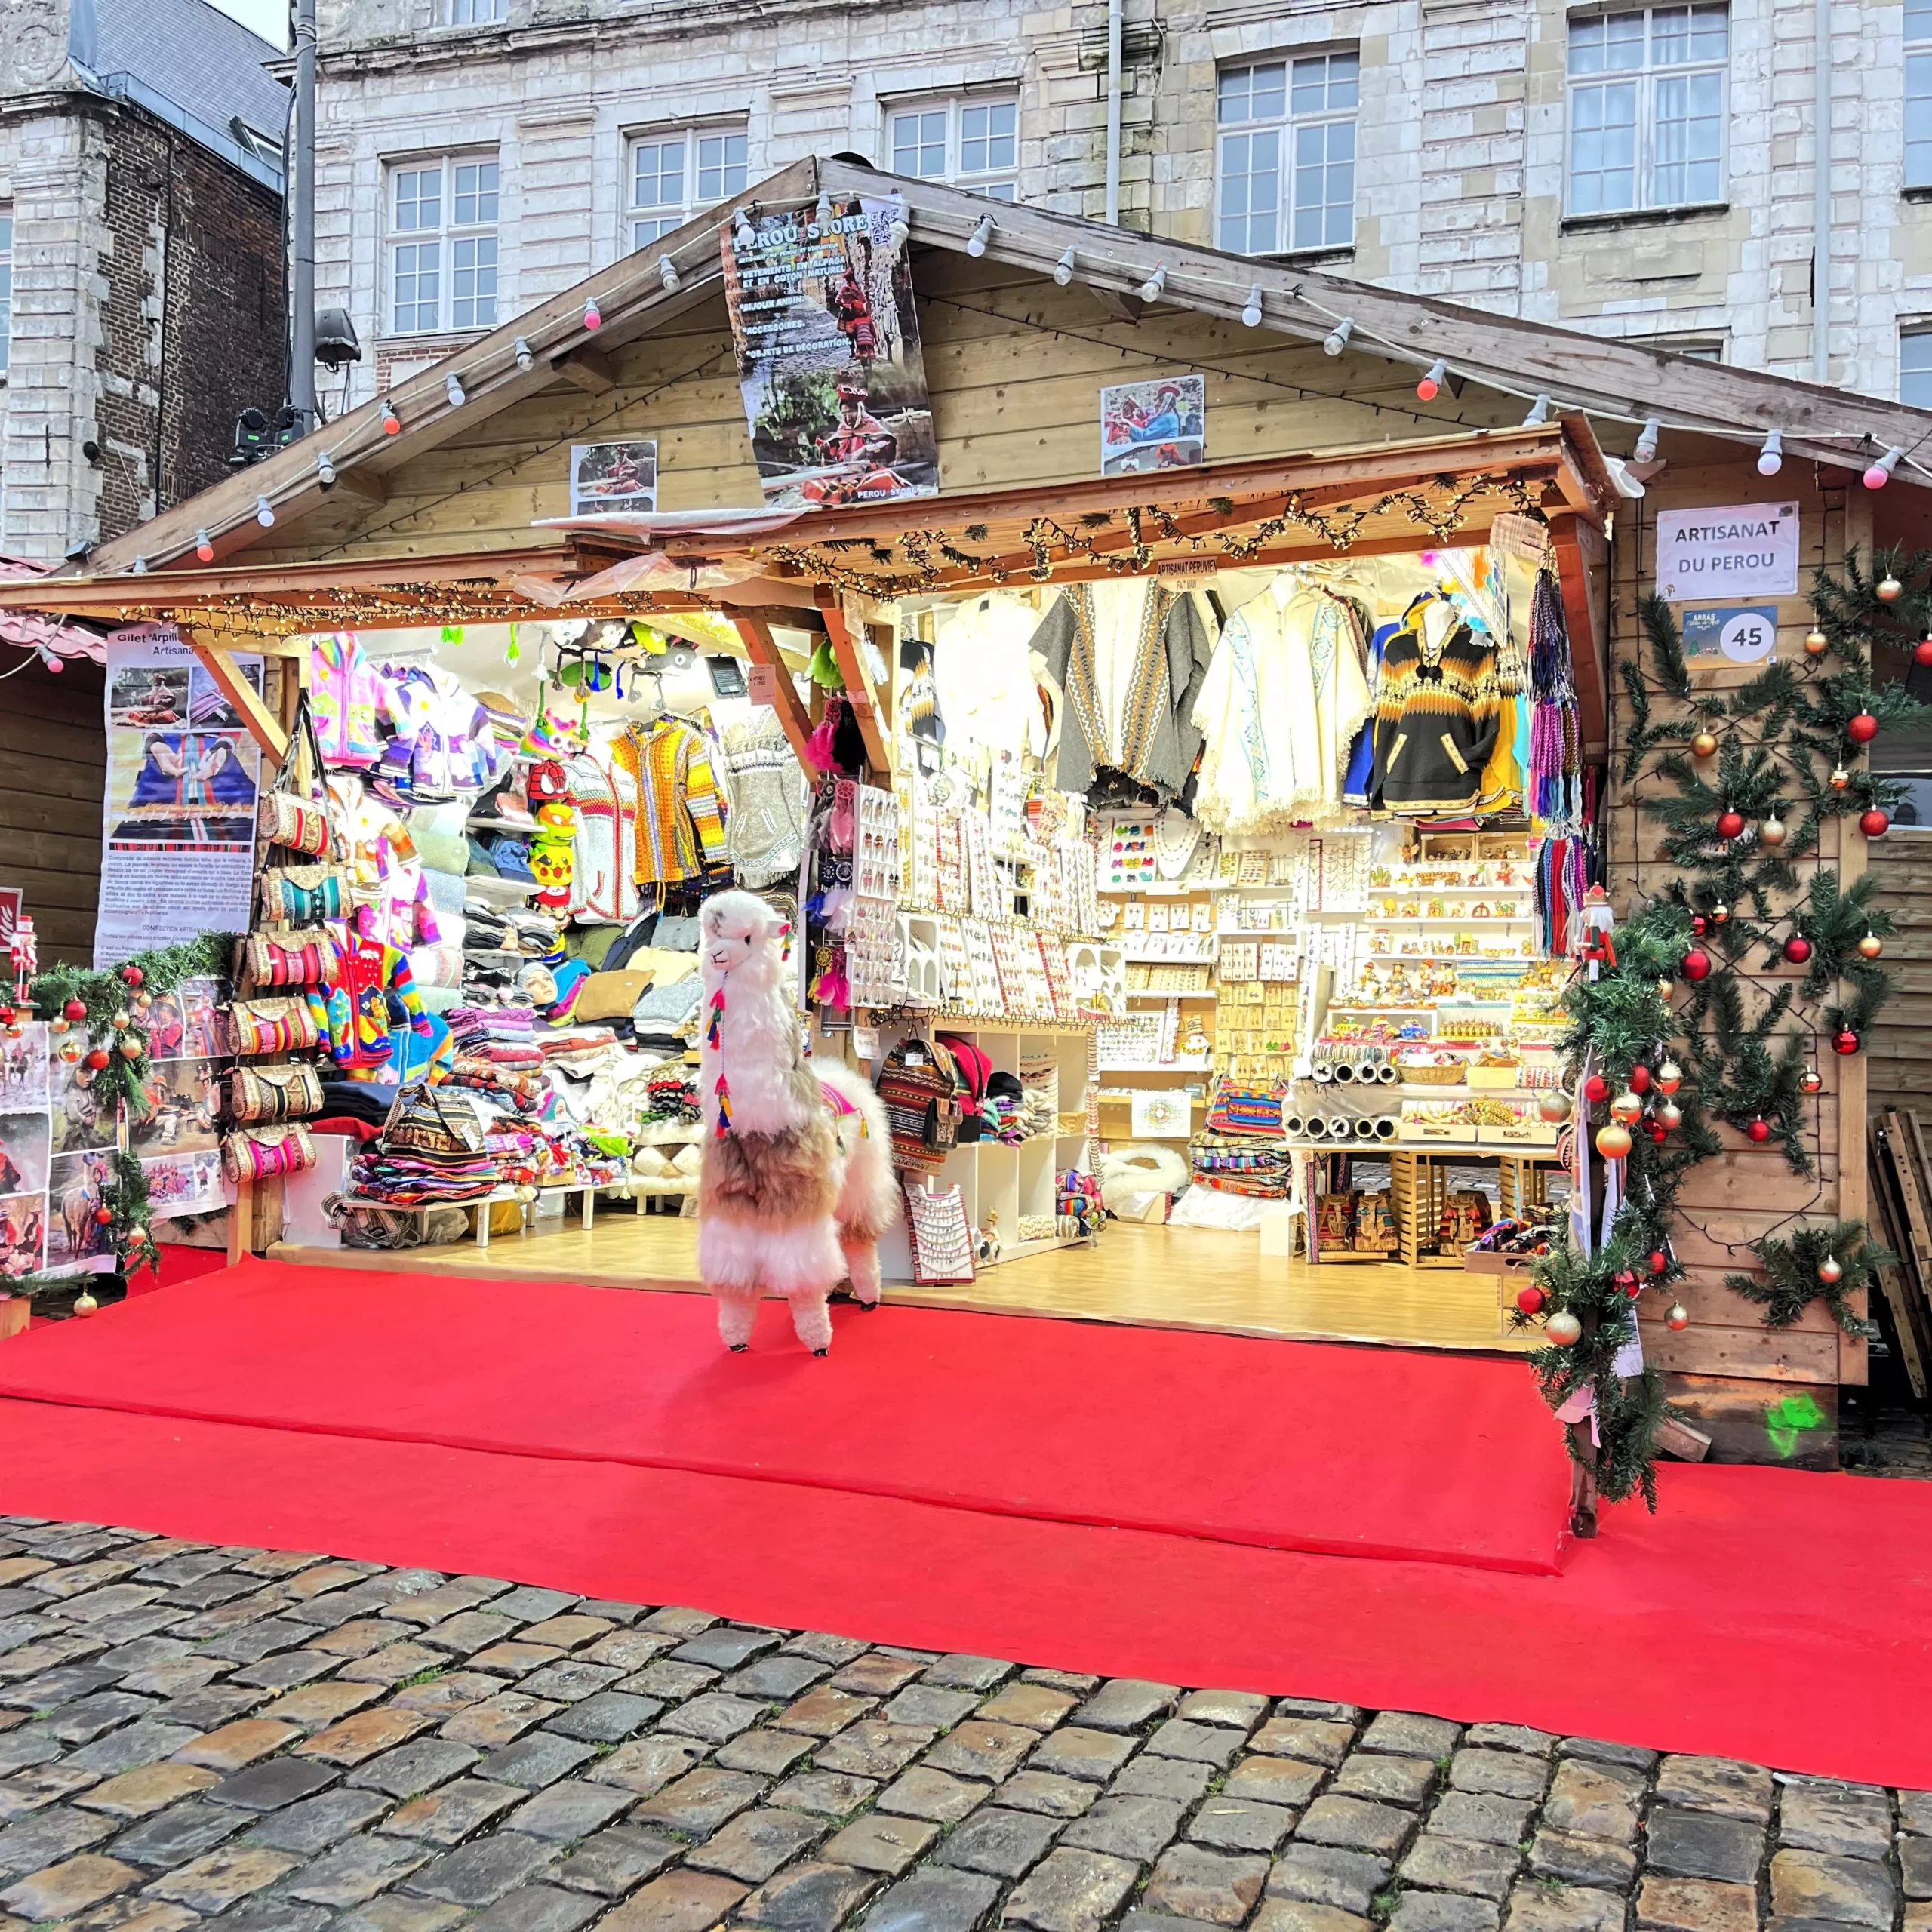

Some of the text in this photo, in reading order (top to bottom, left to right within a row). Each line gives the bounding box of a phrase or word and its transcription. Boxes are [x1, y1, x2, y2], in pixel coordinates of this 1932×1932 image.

[796, 262, 808, 271] EN
[813, 256, 845, 268] ALPAGA
[743, 264, 846, 288] ET EN COTON NATUREL
[783, 345, 793, 353] DE
[857, 487, 917, 499] PEROU STORE
[1675, 521, 1780, 543] ARTISANAT
[1158, 561, 1189, 576] ARTISANAT
[1678, 552, 1774, 574] DU PEROU
[1693, 613, 1716, 621] ARRAS
[117, 632, 178, 644] Gilet "Arpill
[1731, 627, 1762, 647] 45
[152, 645, 194, 655] Artisana
